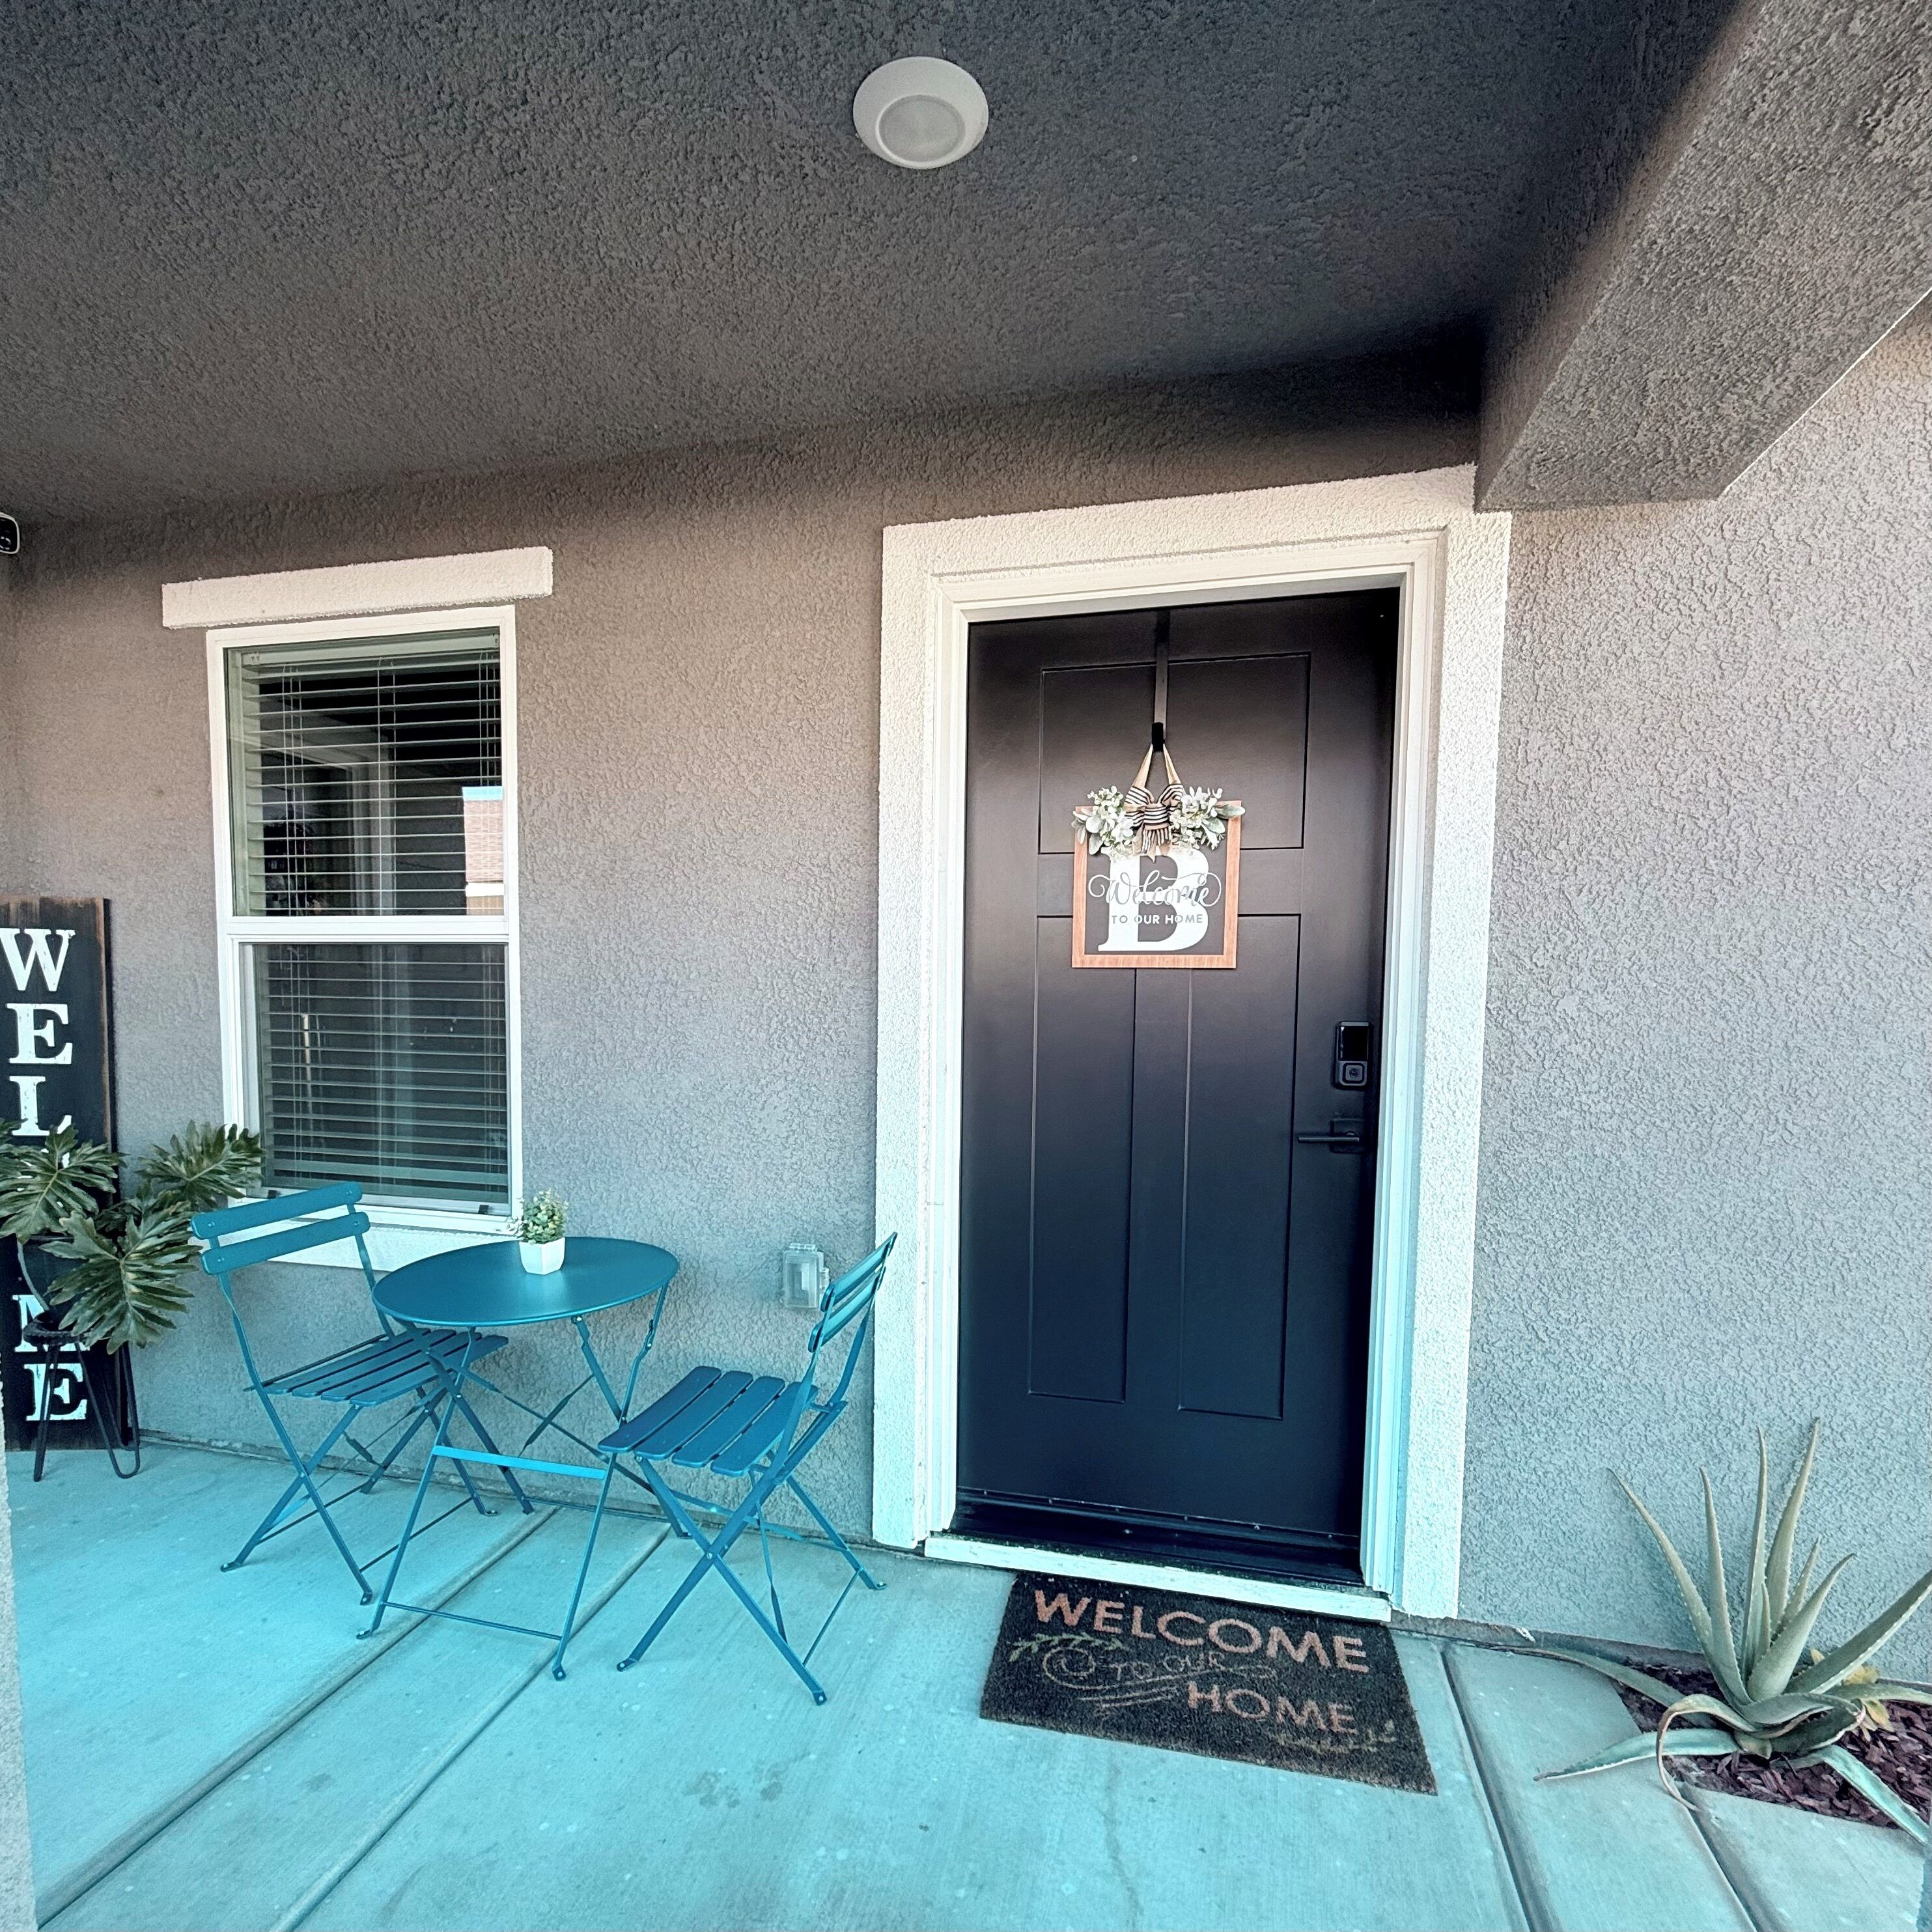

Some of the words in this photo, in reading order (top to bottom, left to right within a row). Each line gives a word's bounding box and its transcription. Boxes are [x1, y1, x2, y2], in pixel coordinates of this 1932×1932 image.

[1088, 870, 1222, 907] Welcome
[1098, 846, 1209, 951] B
[1111, 914, 1128, 925] TO
[1134, 914, 1160, 925] OUR
[1164, 914, 1203, 925] HOME
[1035, 1589, 1369, 1673] WELCOME
[1187, 1680, 1358, 1735] HOME
